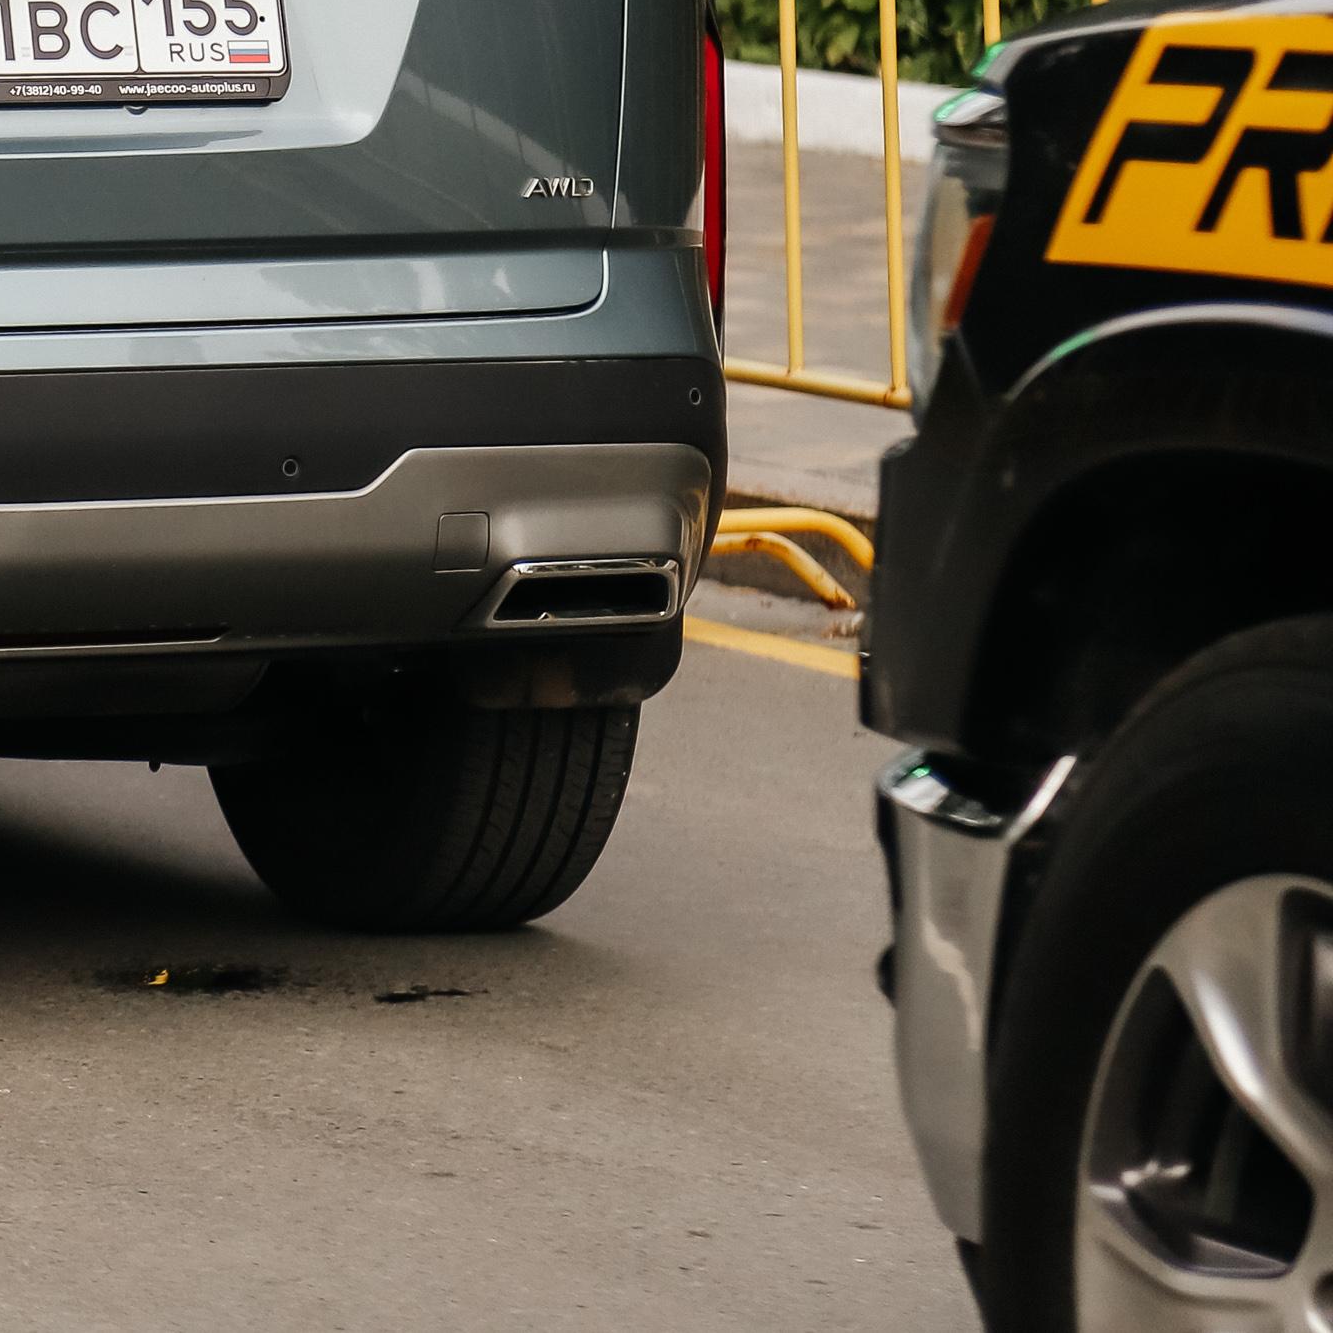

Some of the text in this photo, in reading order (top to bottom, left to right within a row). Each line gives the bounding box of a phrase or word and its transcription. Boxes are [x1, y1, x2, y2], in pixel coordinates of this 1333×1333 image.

[169, 43, 225, 63] RUS
[118, 81, 256, 96] www.jaecoo-autoplus.ru
[1081, 44, 1333, 245] PR
[520, 177, 594, 198] AWD
